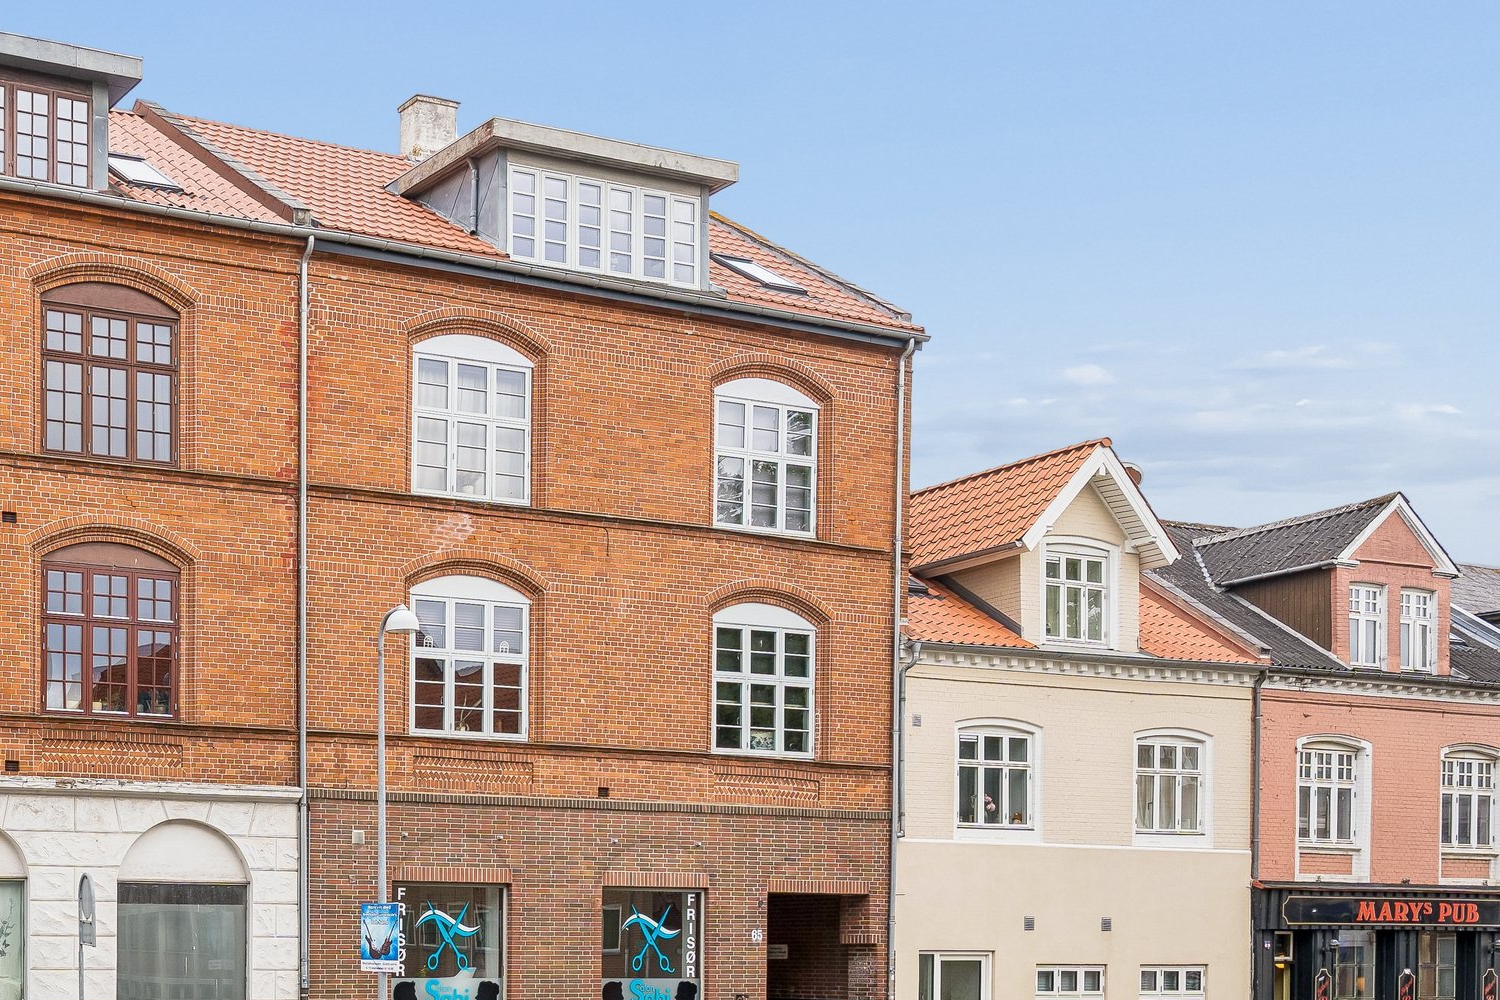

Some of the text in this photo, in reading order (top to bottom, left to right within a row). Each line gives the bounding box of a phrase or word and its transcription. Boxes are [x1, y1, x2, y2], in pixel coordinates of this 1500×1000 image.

[396, 887, 406, 977] FRISØR
[686, 893, 696, 978] FRISØR
[751, 929, 763, 941] 65
[1438, 902, 1480, 923] PUB
